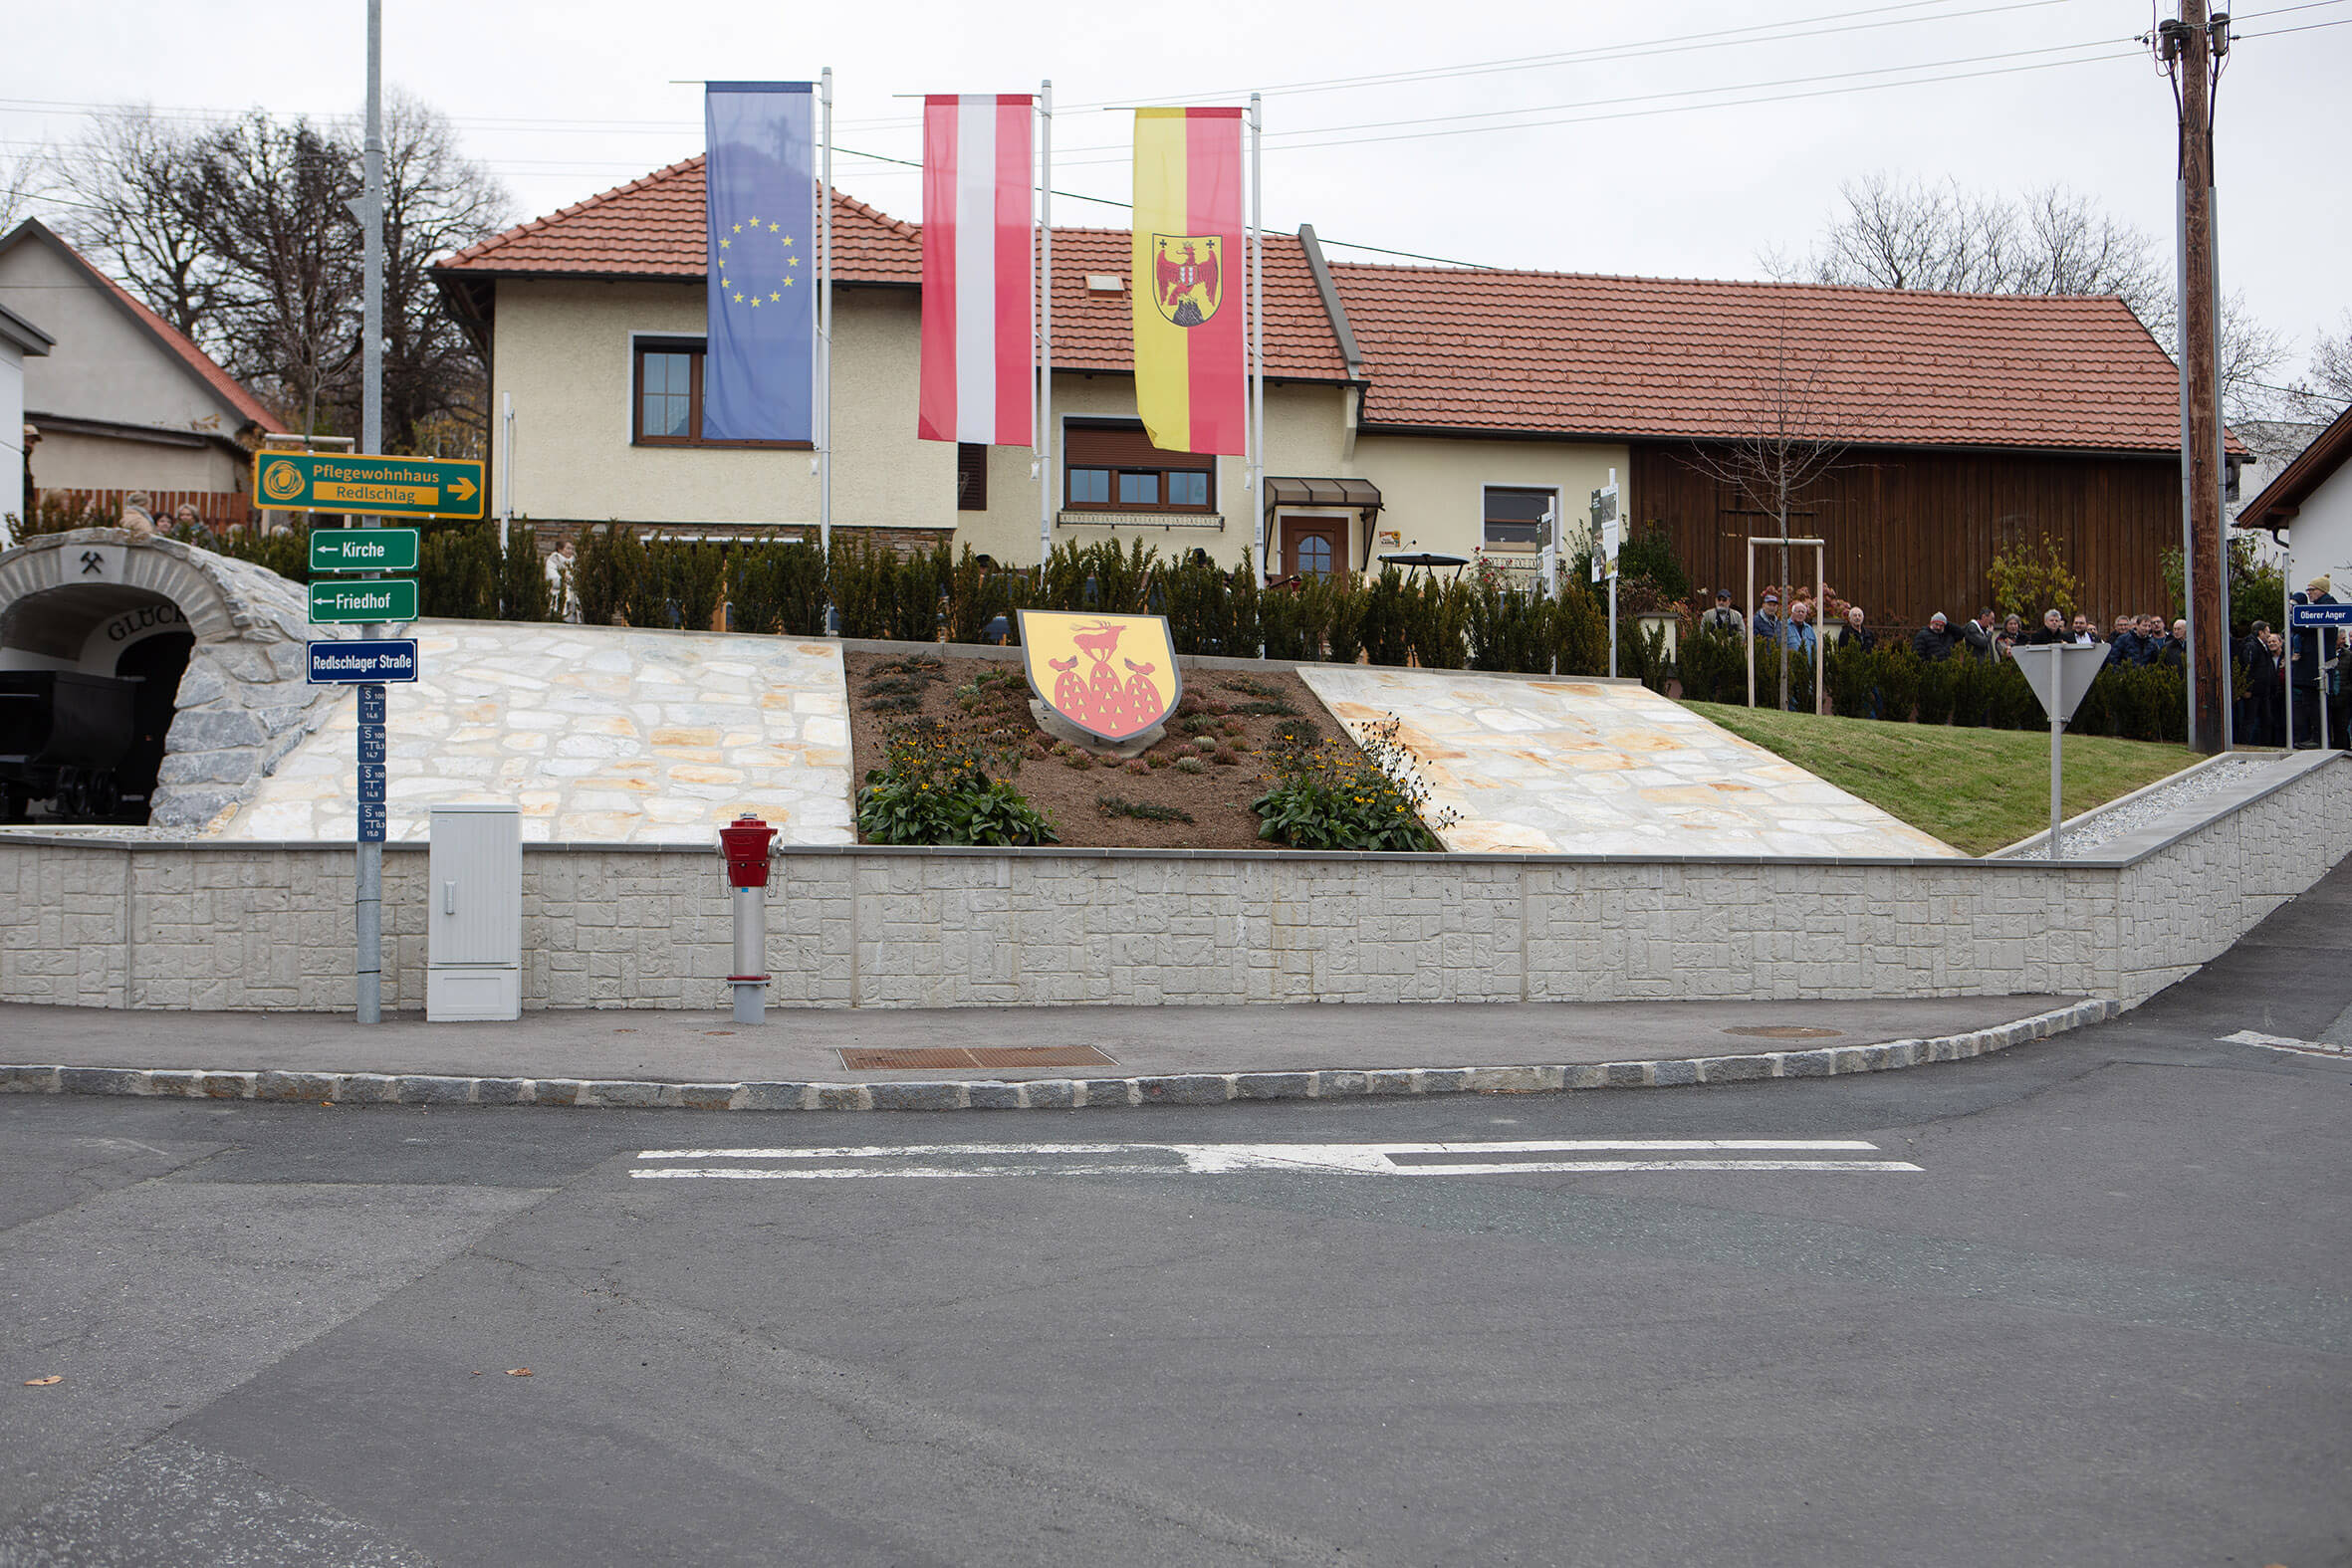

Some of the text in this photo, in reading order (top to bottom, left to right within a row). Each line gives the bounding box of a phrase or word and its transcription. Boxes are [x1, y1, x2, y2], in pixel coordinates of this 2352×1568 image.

[313, 464, 439, 483] Pflegewohnhaus
[337, 486, 415, 505] Redlschlag
[342, 542, 384, 558] Kirche
[336, 592, 390, 609] Friedhof
[2325, 610, 2346, 620] Anger
[313, 653, 412, 673] Redlschlager Straße
[364, 690, 371, 700] S
[364, 729, 372, 739] S
[364, 769, 372, 779] S
[364, 807, 372, 817] S
